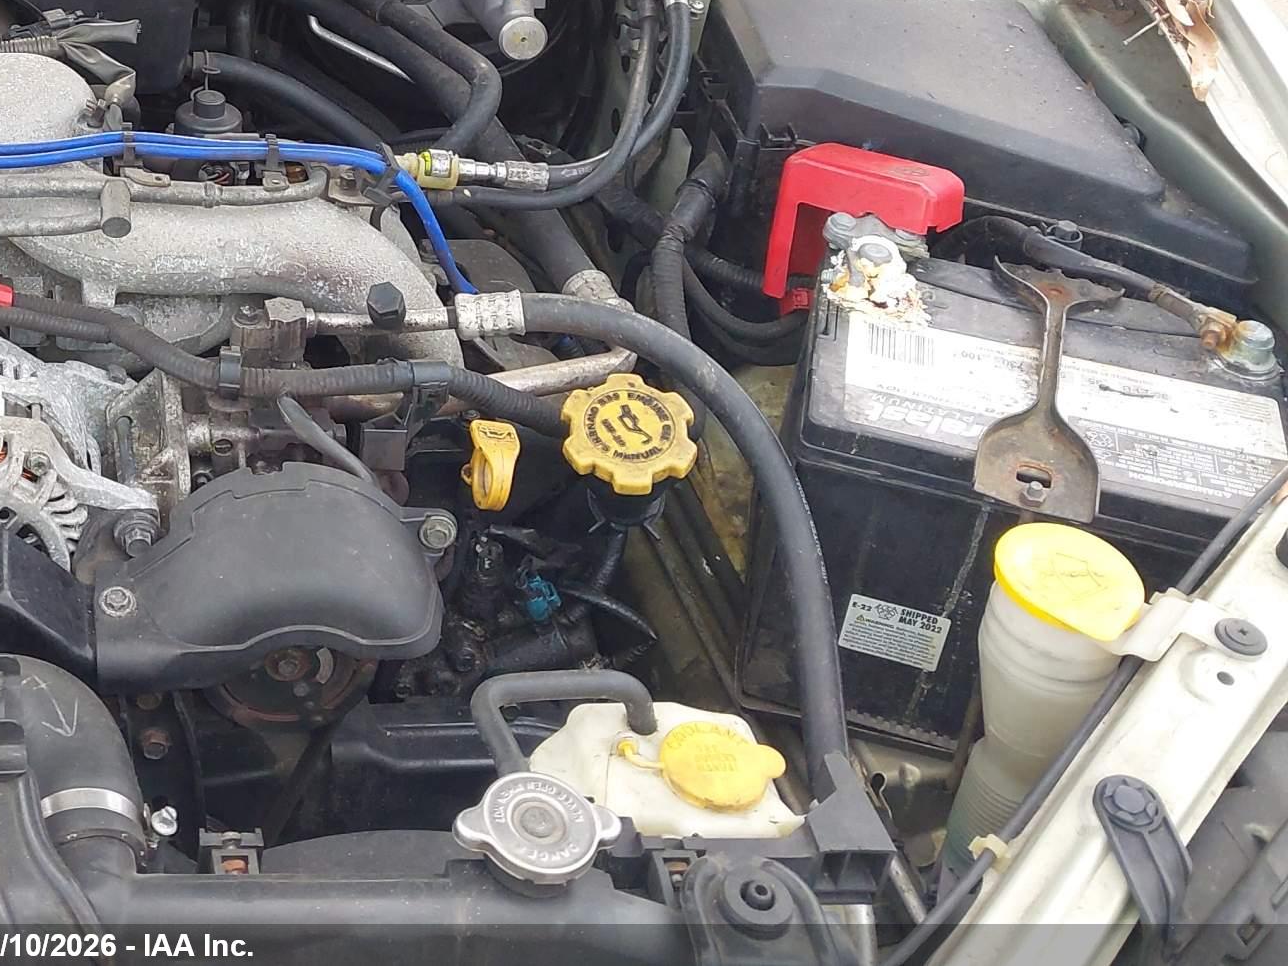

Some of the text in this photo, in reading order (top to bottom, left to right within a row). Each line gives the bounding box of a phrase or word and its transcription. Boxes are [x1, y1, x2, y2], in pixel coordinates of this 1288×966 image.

[870, 393, 974, 423] PLATINUM
[866, 400, 983, 445] ralast
[612, 446, 663, 460] MANUAL
[898, 616, 943, 634] MAY 2022
[901, 609, 938, 623] SHIPPED
